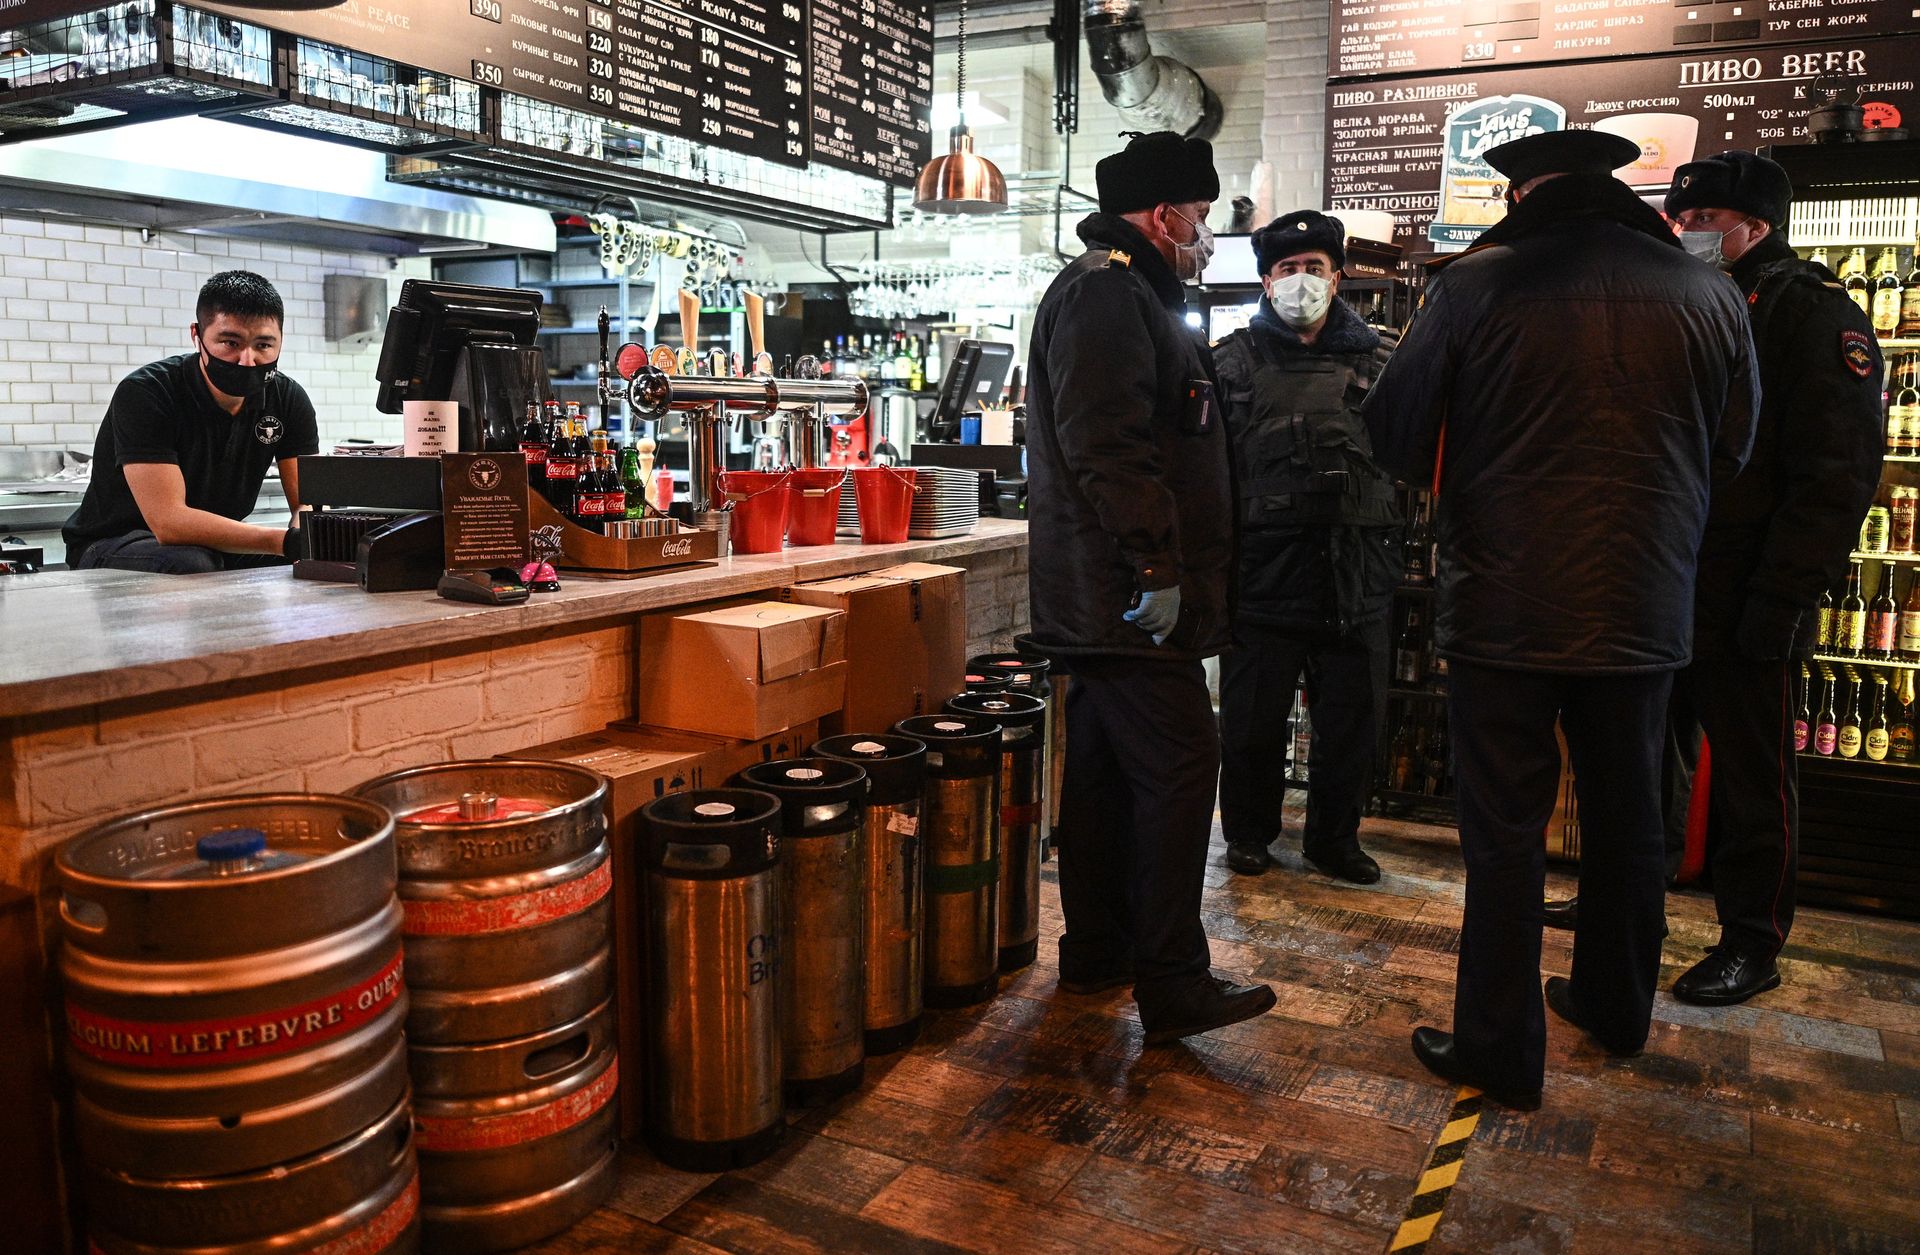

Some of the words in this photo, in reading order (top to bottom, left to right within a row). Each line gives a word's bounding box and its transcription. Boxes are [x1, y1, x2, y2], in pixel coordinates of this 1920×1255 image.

[368, 7, 411, 30] PEACE
[475, 0, 501, 20] 390
[562, 5, 580, 18] ФРИ
[617, 6, 639, 20] САЛАТ
[782, 3, 801, 22] 890
[1341, 6, 1376, 17] МУСКАТ
[510, 13, 549, 34] ЛУКОВЫЕ
[552, 26, 583, 45] КОЛЬЦА
[590, 9, 612, 31] 150
[740, 15, 766, 34] STEAK
[1341, 23, 1359, 32] ГАЙ
[1554, 19, 1599, 31] ХАРДИС
[1603, 15, 1645, 28] ШИРАЗ
[1768, 19, 1792, 31] ТУР
[1796, 17, 1821, 29] СЕН
[1827, 13, 1869, 26] ЖОРЖ
[617, 25, 642, 40] САЛАТ
[700, 27, 719, 46] 180
[1340, 35, 1370, 46] АЛЬТА
[1374, 31, 1404, 43] ВИСТА
[590, 33, 613, 55] 220
[1340, 43, 1382, 54] ПРЕМИУМ
[1464, 42, 1495, 59] 330
[1553, 36, 1612, 49] ЛИКУРИЯ
[512, 39, 550, 59] КУРИНЫЕ
[553, 52, 579, 68] БЕДРА
[618, 42, 655, 62] КУКУРУЗА
[701, 48, 720, 68] 170
[476, 63, 502, 86] 350
[590, 58, 614, 80] 320
[785, 58, 802, 76] 200
[1679, 57, 1762, 86] ПИВО
[513, 67, 546, 84] СЫРНОЕ
[549, 77, 583, 95] АССОРТИ
[785, 78, 802, 96] 200
[1856, 81, 1914, 94] (СЕРБИЯ)
[590, 85, 614, 106] 350
[618, 91, 646, 107] ОЛИВКИ
[701, 93, 721, 111] 340
[1333, 91, 1375, 106] ПИВО
[1383, 82, 1479, 102] РАЗЛИВНОЕ
[1703, 93, 1755, 109] 500мл
[1584, 100, 1625, 113] Джоус
[1627, 96, 1680, 109] (РОССИЯ)
[702, 118, 721, 137] 250
[787, 120, 800, 135] 90
[1333, 117, 1372, 129] ВЕЛКА
[1378, 112, 1426, 126] МОРАВА
[1469, 106, 1527, 138] JAWS
[786, 140, 803, 156] 150
[862, 151, 877, 167] 390
[1355, 263, 1386, 275] RESERVED
[171, 1002, 343, 1054] LEFEBVRE
